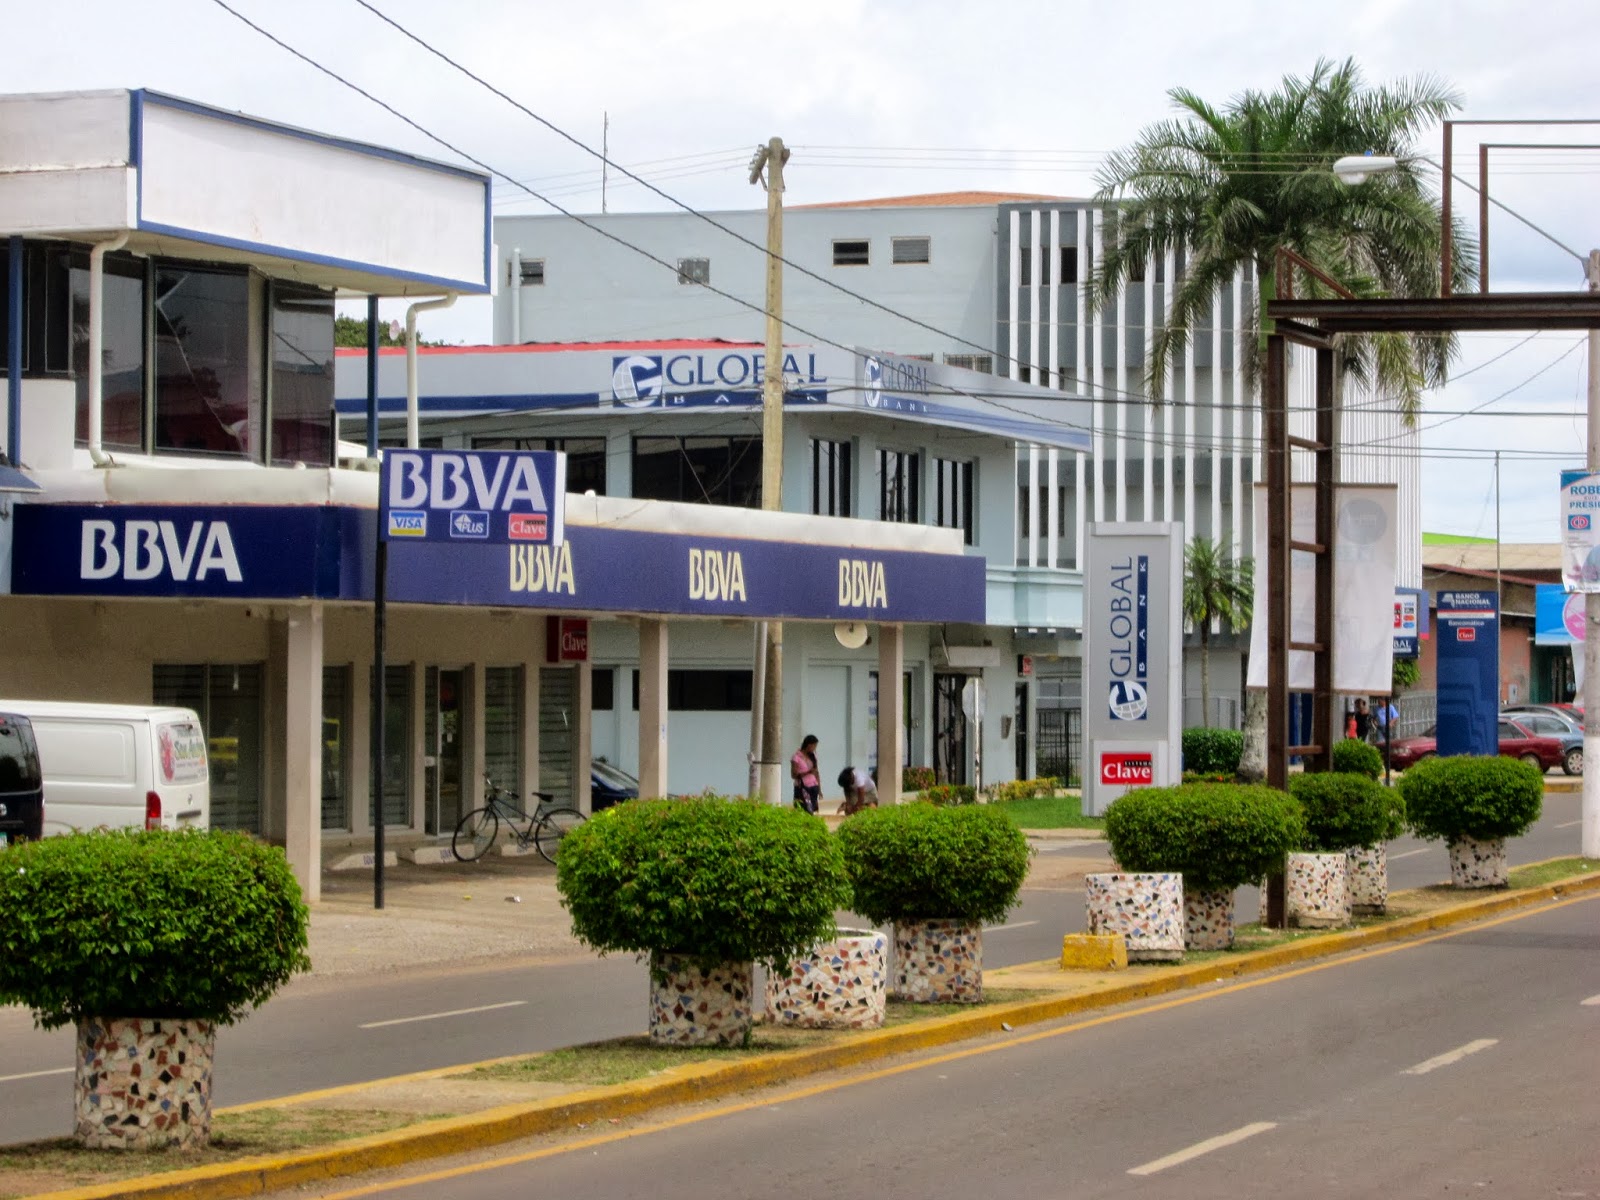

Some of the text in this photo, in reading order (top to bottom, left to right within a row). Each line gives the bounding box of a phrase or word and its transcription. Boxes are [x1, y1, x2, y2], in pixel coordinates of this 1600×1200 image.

[666, 353, 827, 386] GLOBAL
[389, 453, 547, 512] BBVA
[395, 518, 422, 529] VISA
[462, 523, 484, 533] PLUS
[510, 521, 545, 534] Clave
[80, 519, 243, 582] BBVA
[509, 539, 576, 595] BBVA
[689, 548, 747, 602] BBVA
[838, 558, 888, 609] BBVA
[563, 632, 586, 652] Clave
[1109, 556, 1132, 678] GLOBAL
[1138, 562, 1147, 672] BANK
[1104, 762, 1151, 779] Clave
